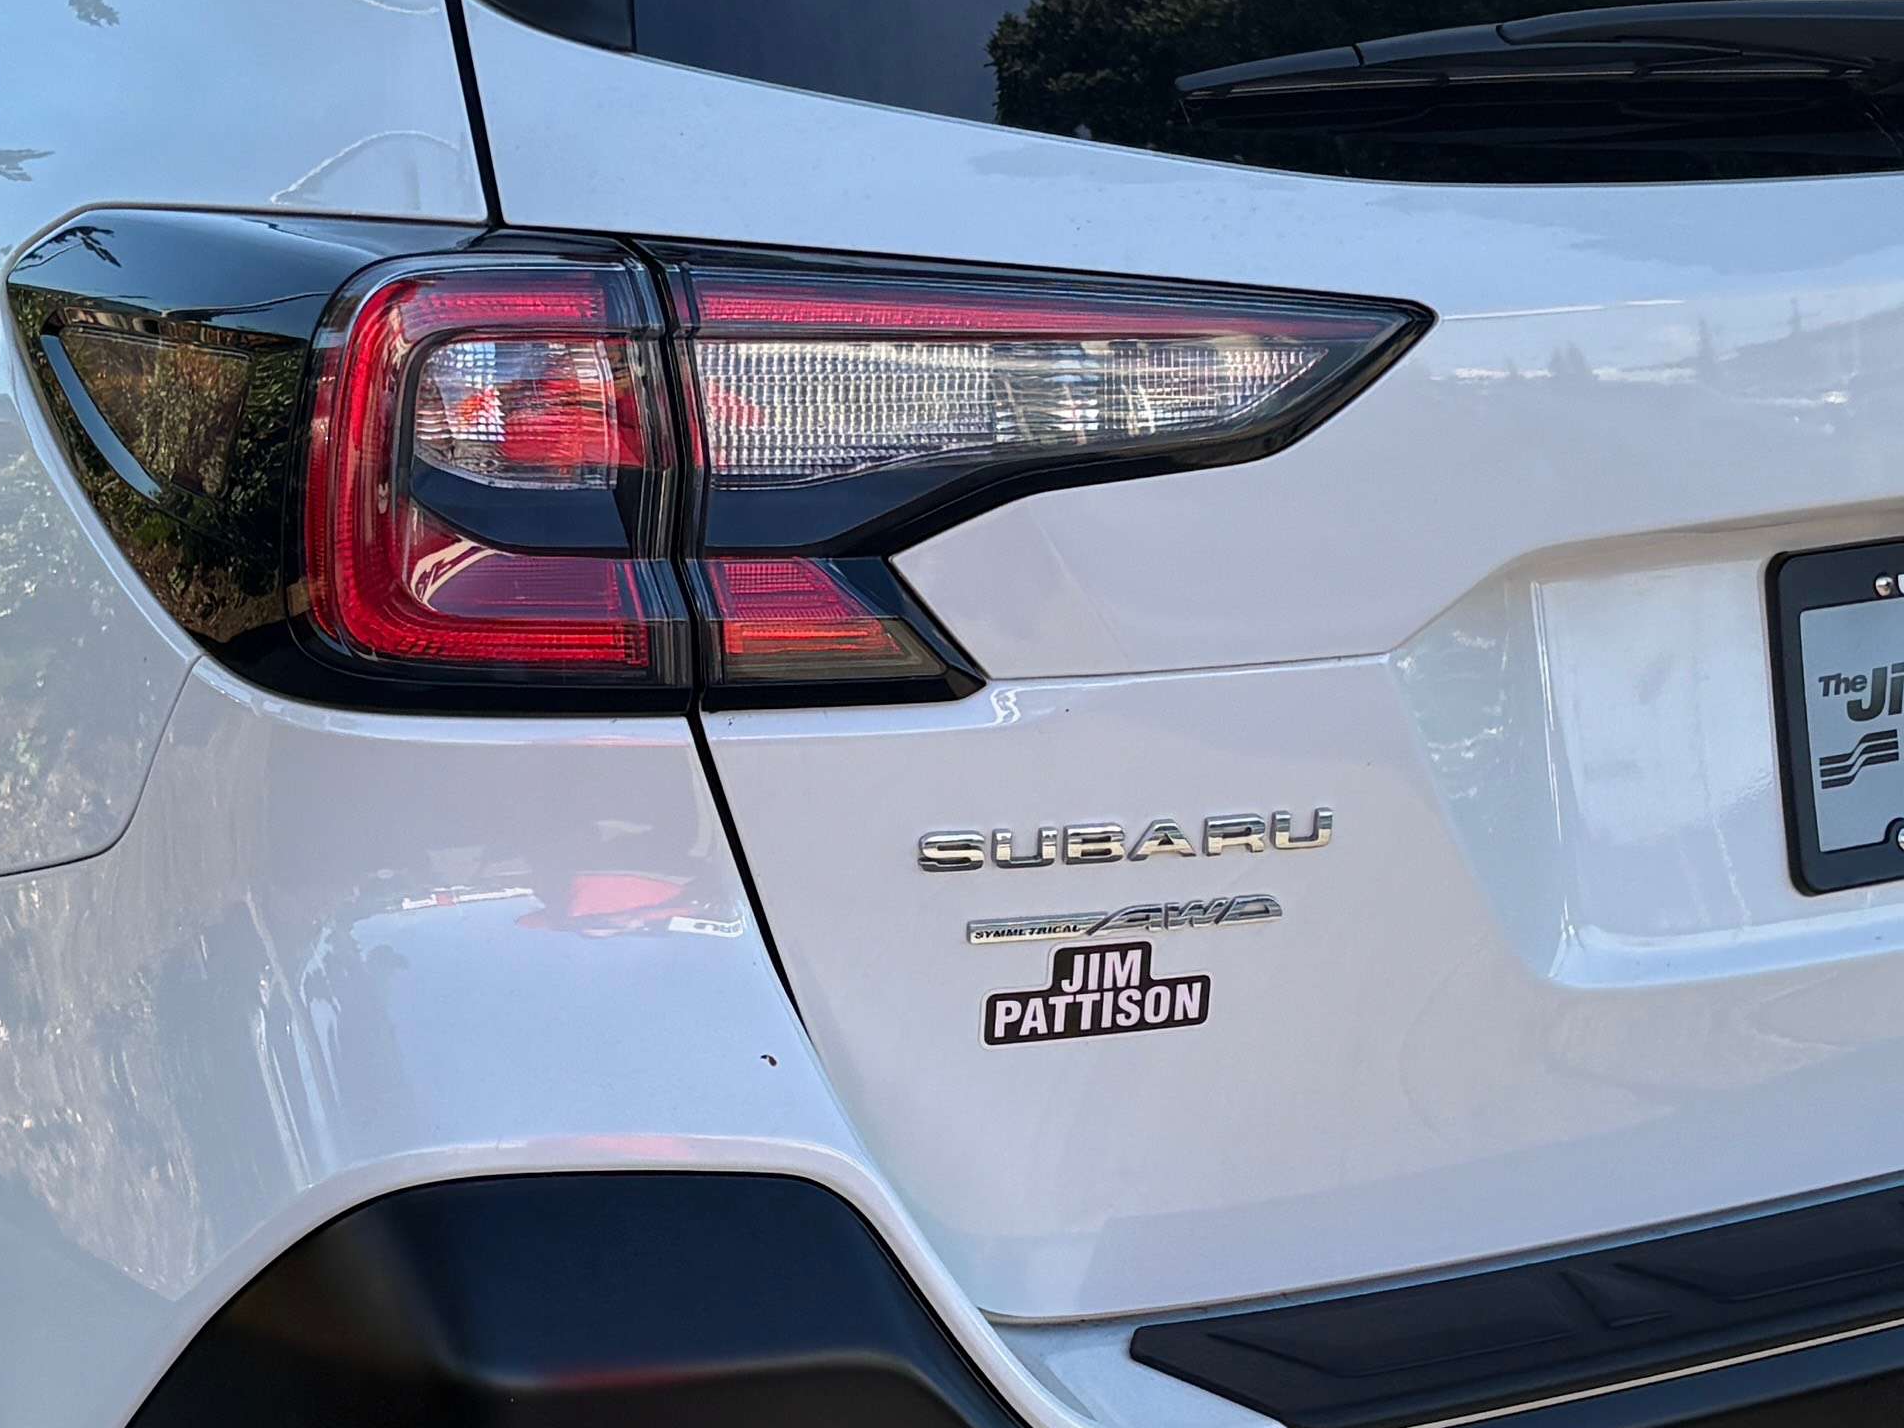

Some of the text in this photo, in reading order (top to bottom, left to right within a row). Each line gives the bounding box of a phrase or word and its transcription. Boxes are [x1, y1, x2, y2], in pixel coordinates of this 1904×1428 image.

[1818, 671, 1867, 698] The
[917, 806, 1335, 872] SUBARU
[975, 892, 1283, 939] SYMMETRICAL AWD
[1060, 948, 1143, 993] JIM
[994, 982, 1203, 1038] PATTISON
